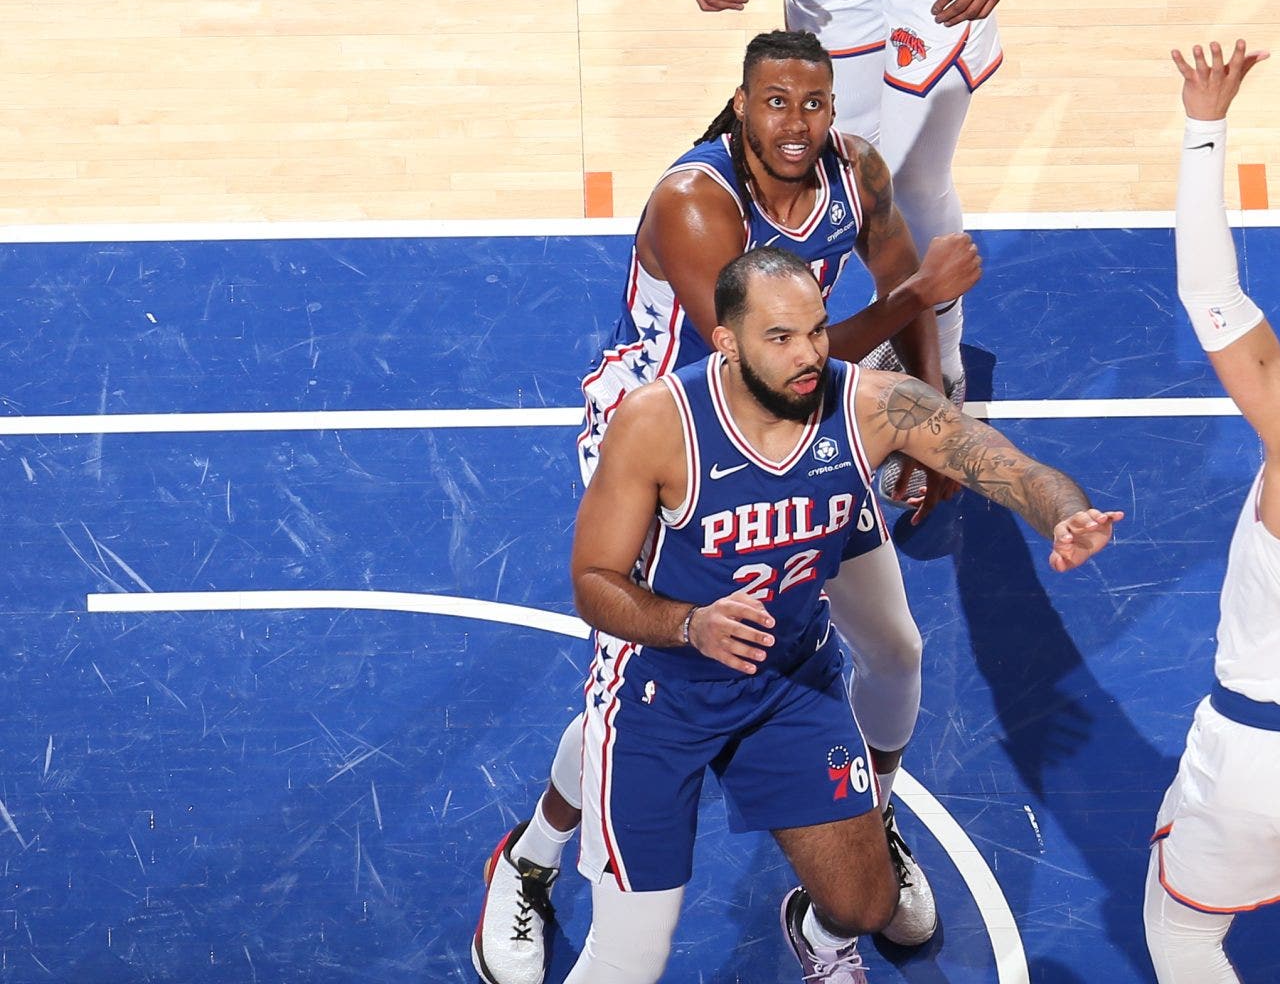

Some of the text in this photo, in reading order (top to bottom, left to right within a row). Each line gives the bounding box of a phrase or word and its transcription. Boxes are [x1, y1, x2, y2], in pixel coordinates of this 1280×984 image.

[808, 460, 852, 478] crypto.com
[700, 492, 857, 559] PHILA
[732, 547, 823, 603] 22
[827, 756, 870, 802] 76
